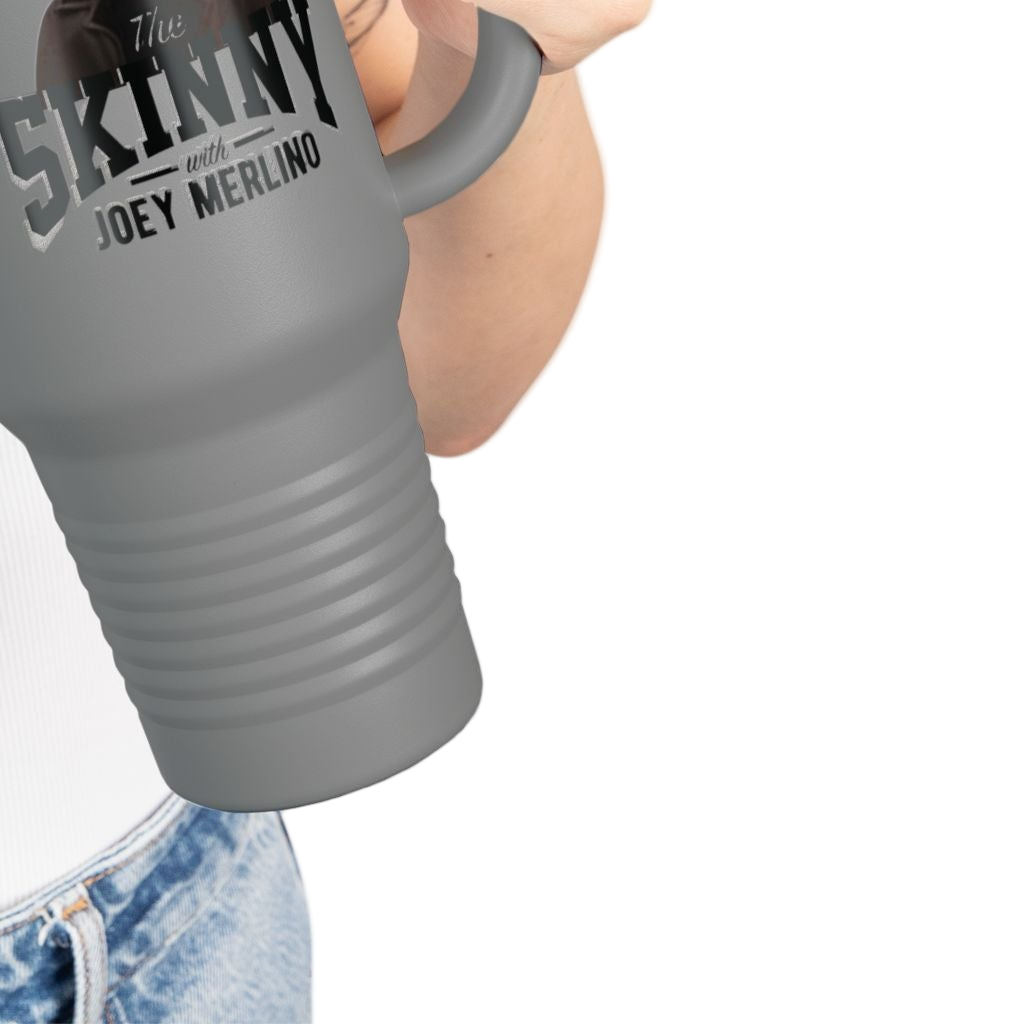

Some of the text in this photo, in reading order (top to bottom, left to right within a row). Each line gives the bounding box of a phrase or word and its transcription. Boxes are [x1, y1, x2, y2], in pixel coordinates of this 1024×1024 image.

[129, 6, 187, 52] The
[185, 136, 230, 174] with
[94, 130, 322, 251] JOEY MERLINO
